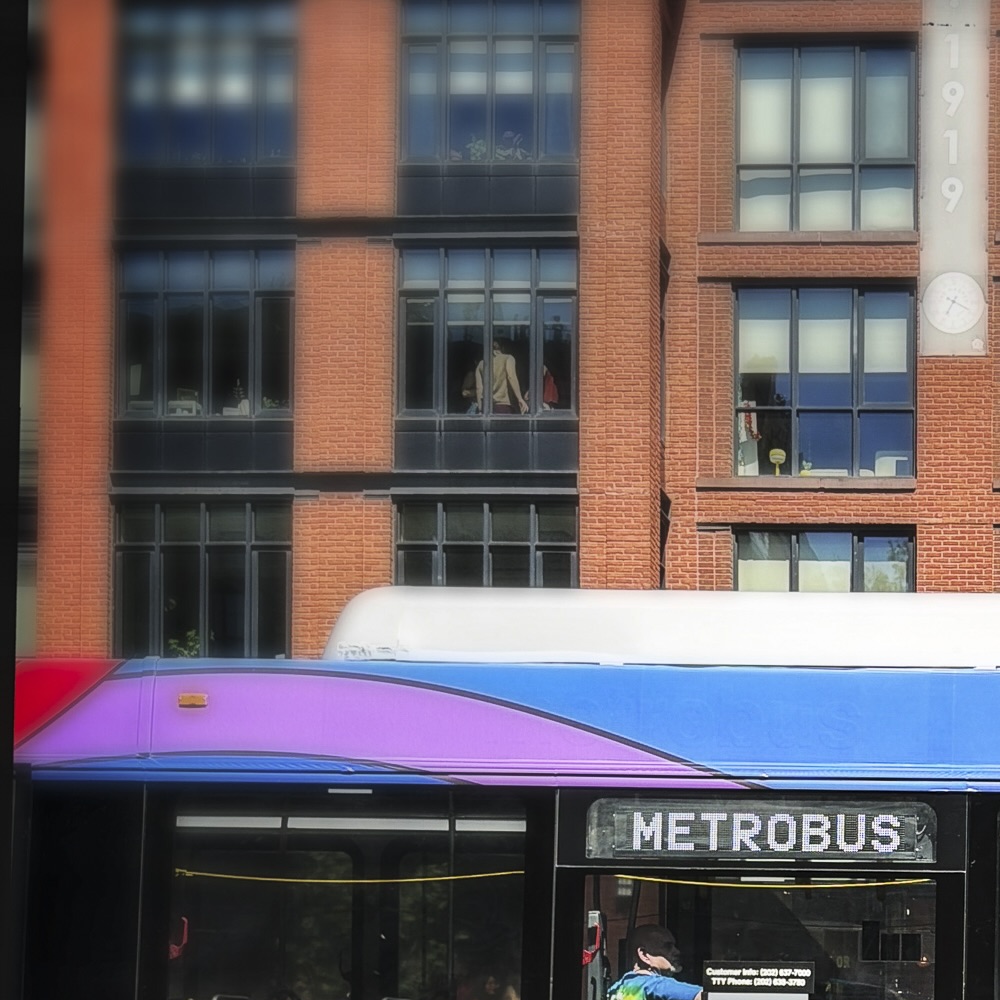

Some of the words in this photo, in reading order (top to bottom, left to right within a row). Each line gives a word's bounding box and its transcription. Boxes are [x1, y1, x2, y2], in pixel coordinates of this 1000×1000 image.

[941, 33, 965, 214] 1919
[632, 811, 901, 852] METROBUS
[706, 967, 742, 976] Customer
[711, 977, 727, 986] TTY
